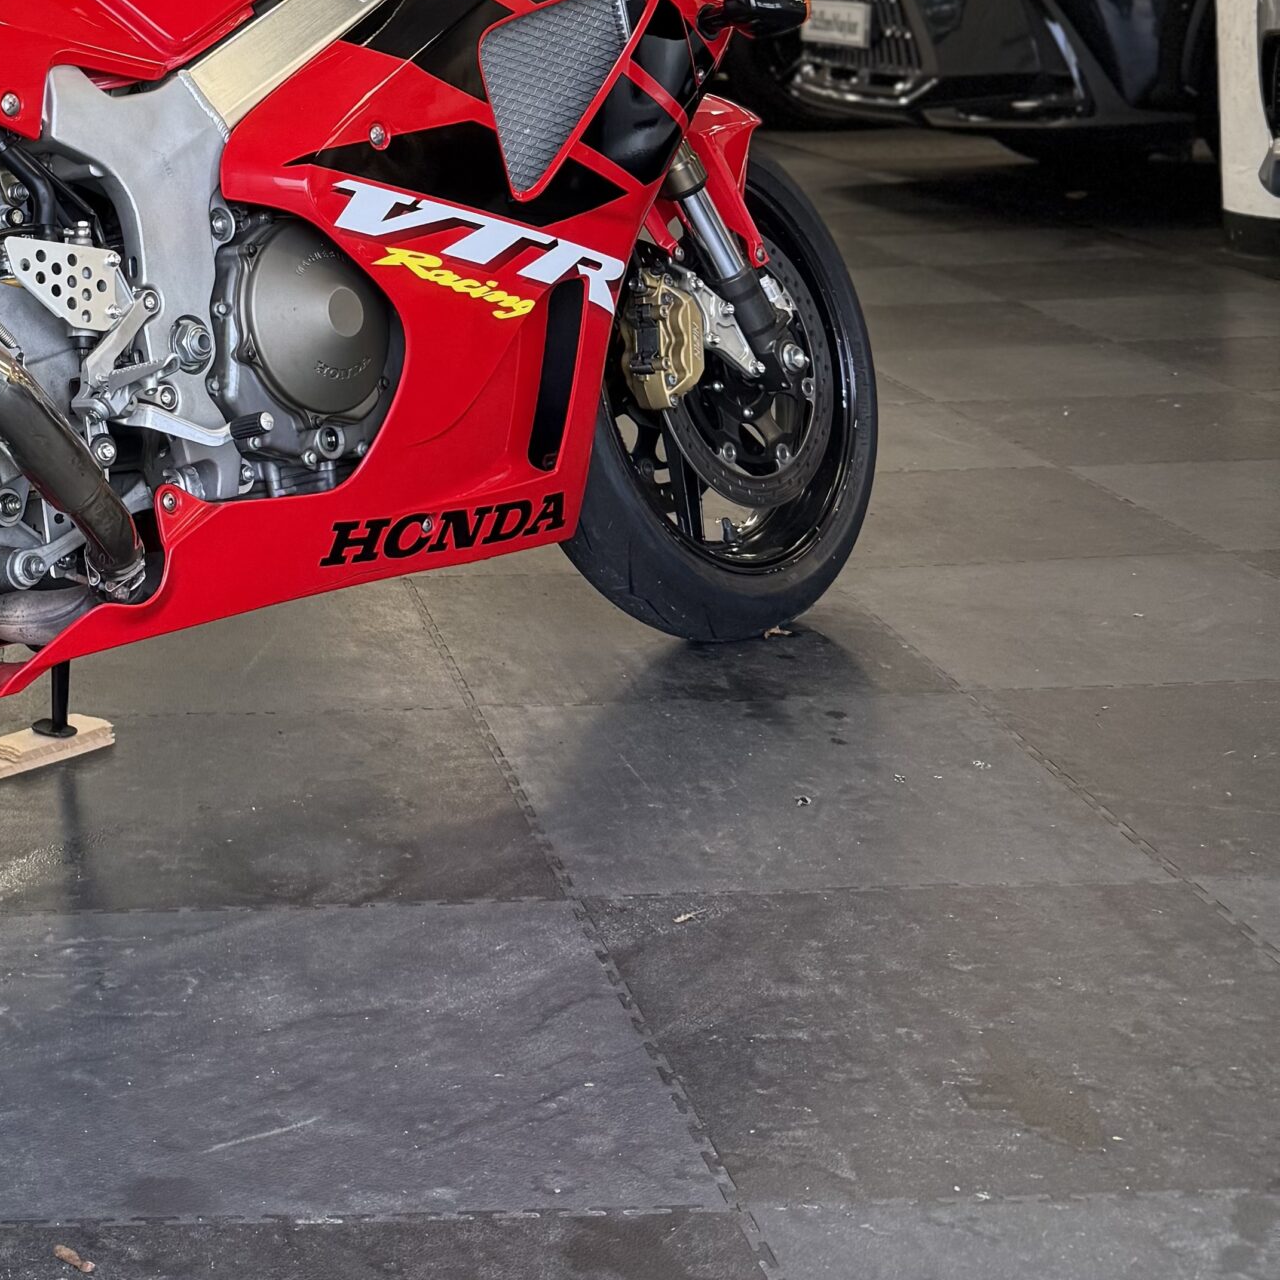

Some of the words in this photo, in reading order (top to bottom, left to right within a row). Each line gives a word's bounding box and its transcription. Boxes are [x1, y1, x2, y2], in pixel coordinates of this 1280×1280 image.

[331, 179, 626, 317] VTR
[371, 247, 536, 320] Racing
[319, 491, 567, 567] HONDA
